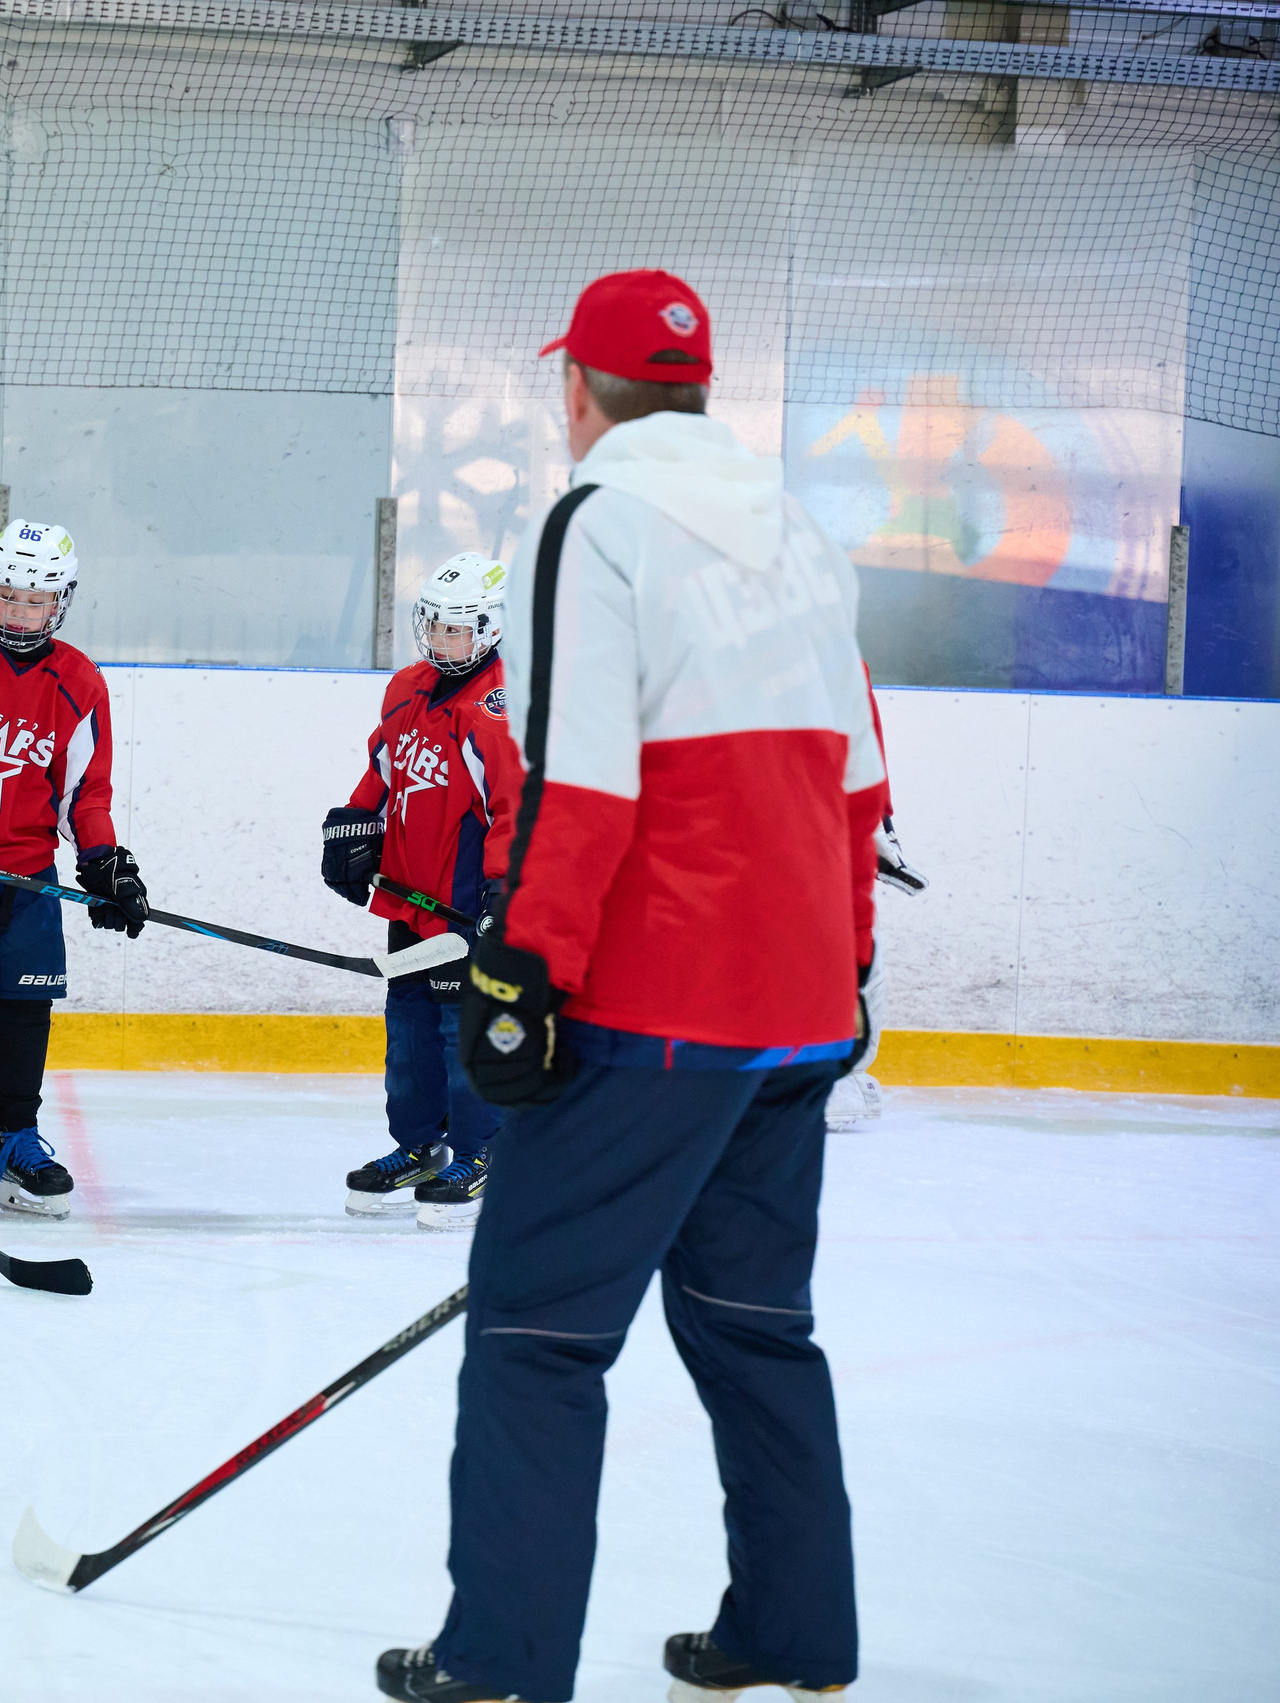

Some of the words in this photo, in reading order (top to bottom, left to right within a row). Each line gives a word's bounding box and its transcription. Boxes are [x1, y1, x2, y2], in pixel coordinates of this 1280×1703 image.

[18, 528, 44, 542] 86
[437, 569, 460, 583] 19
[487, 601, 504, 610] BAU
[322, 821, 386, 841] WARRIOR
[350, 843, 368, 855] COVERT
[40, 885, 101, 907] BAU
[429, 979, 461, 991] UER
